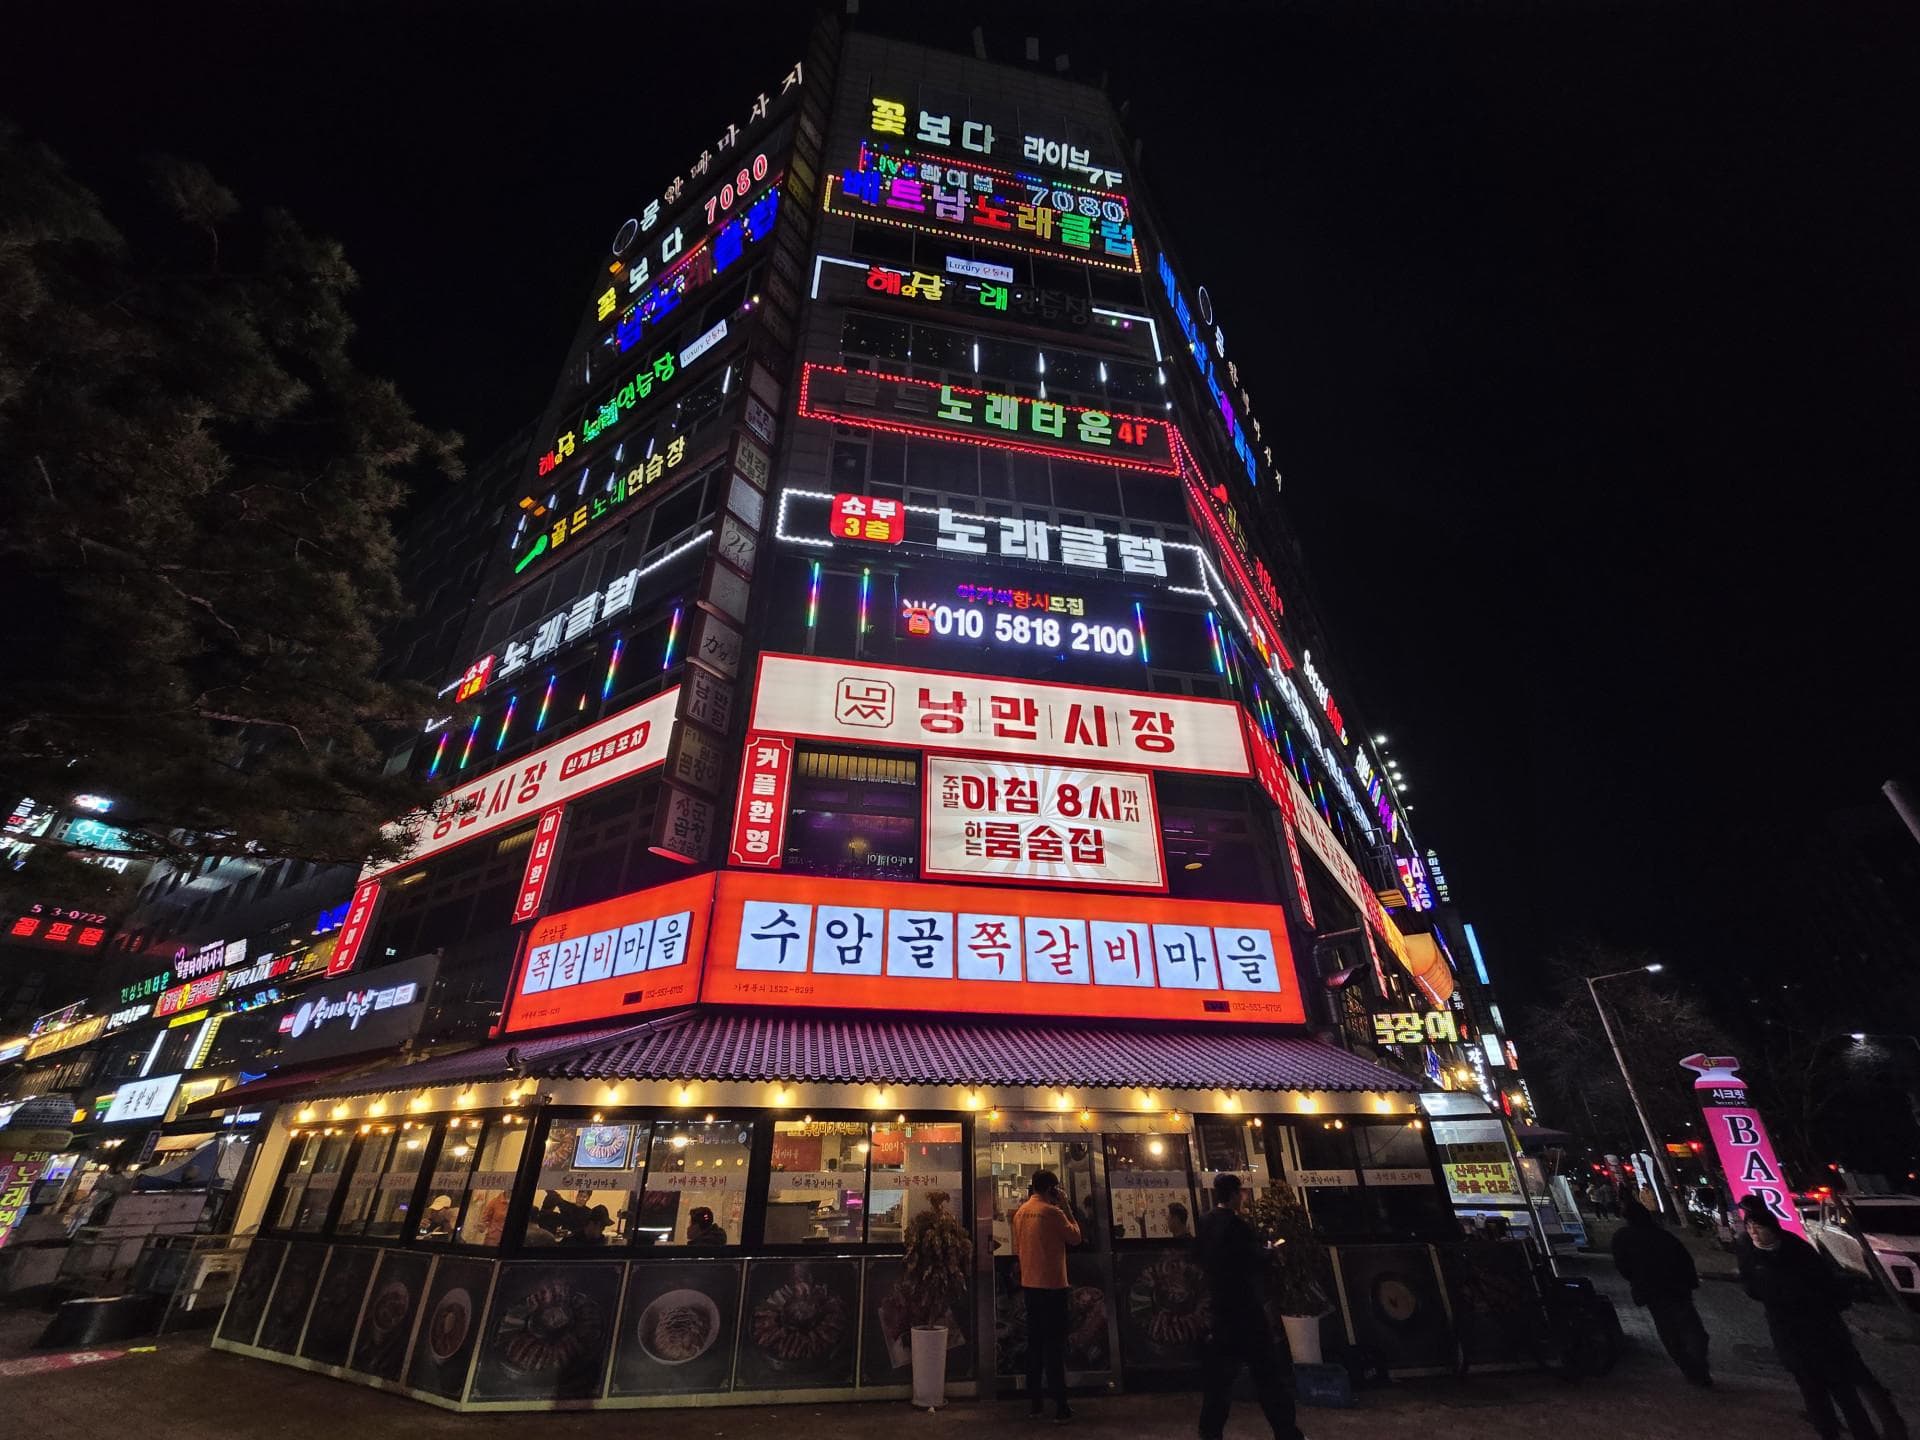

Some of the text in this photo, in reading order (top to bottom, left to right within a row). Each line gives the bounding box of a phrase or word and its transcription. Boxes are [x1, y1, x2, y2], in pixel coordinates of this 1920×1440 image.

[704, 153, 769, 225] 7080
[1023, 135, 1091, 170] 라이브
[1090, 165, 1122, 188] 7F
[1029, 183, 1128, 223] 7080
[937, 385, 1112, 446] 노래타운
[1117, 422, 1148, 446] 4F
[841, 496, 896, 519] 쇼부
[844, 518, 891, 541] 3층
[937, 508, 1168, 577] 노래클럽
[499, 569, 640, 679] 노래클럽
[935, 605, 1134, 656] 010 5818 2100
[917, 687, 1176, 753] 낭만시장
[747, 746, 780, 853] 커플환영
[961, 775, 1039, 814] 아침
[1057, 783, 1120, 821] 8시
[531, 919, 682, 987] 쪽갈비마을
